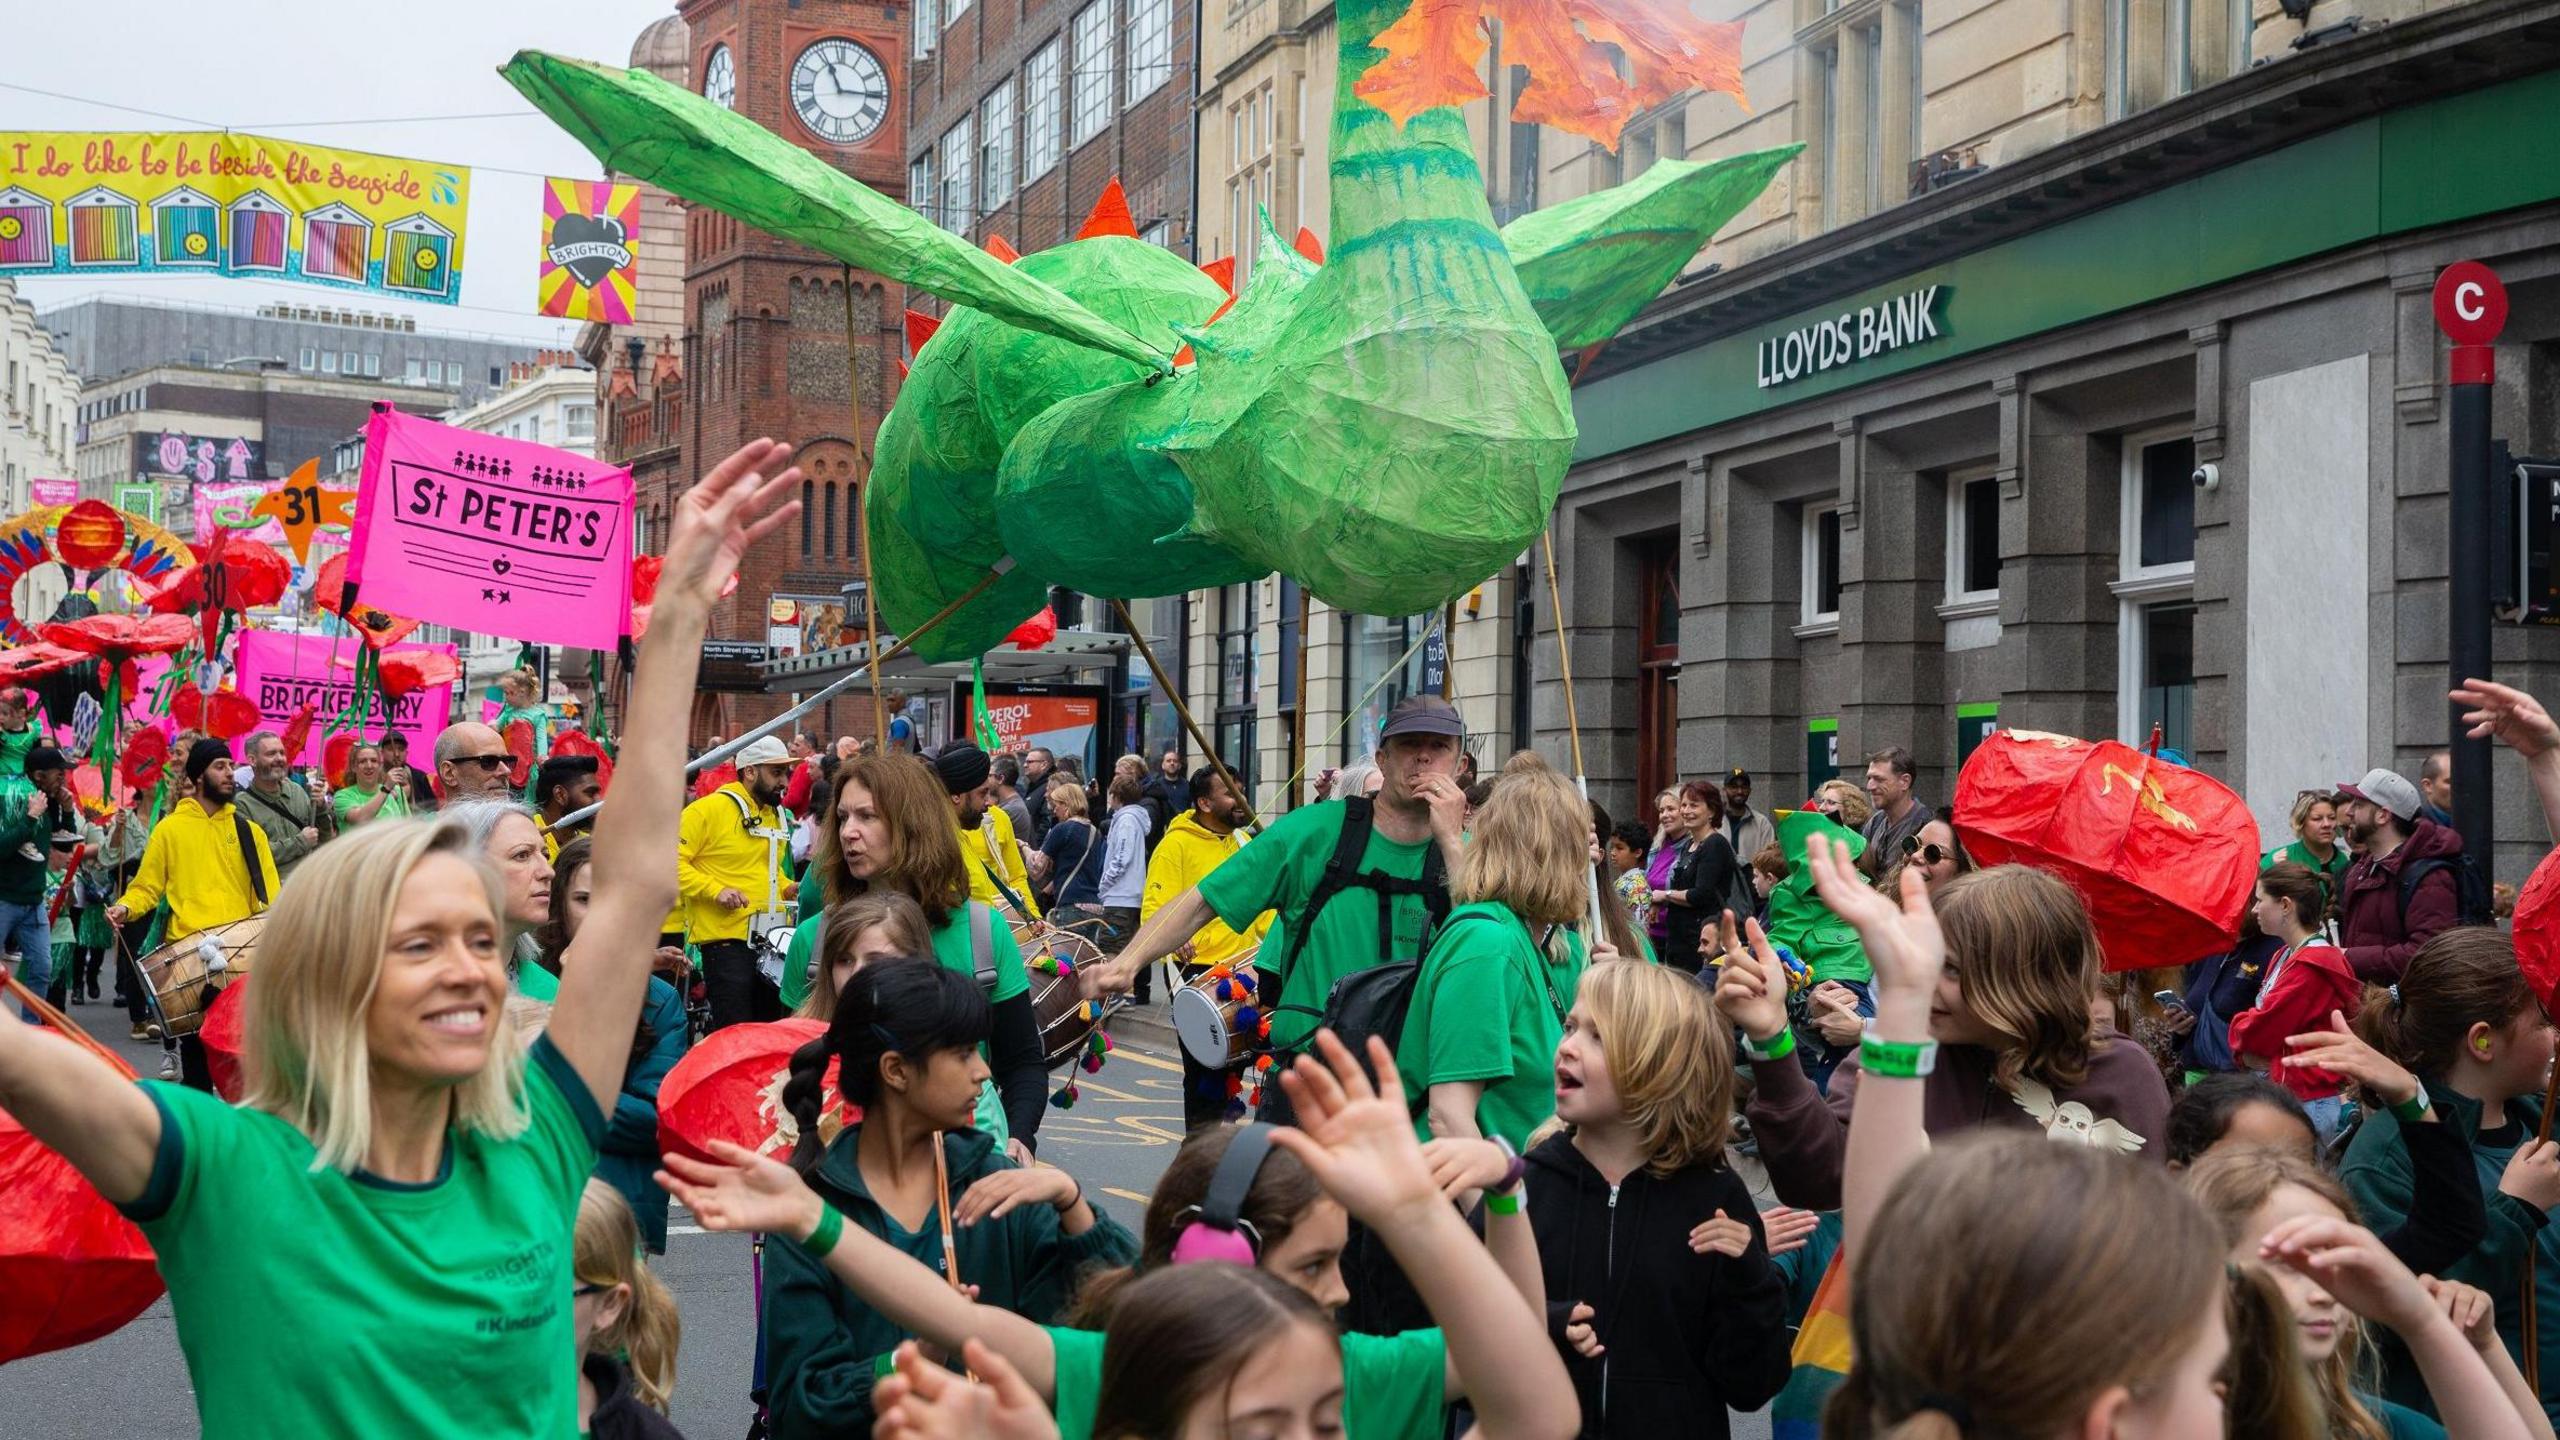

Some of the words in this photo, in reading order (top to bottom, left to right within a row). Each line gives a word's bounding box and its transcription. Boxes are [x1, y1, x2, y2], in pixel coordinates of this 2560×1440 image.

[10, 143, 31, 173] I
[37, 145, 73, 177] do
[83, 138, 133, 174] like
[141, 142, 168, 177] to
[176, 141, 203, 178] be
[209, 142, 277, 180] beside
[283, 151, 322, 185] the
[554, 243, 628, 263] BRIGHTON
[2455, 281, 2485, 321] C
[1758, 313, 1852, 388] LLOYDS
[1859, 285, 1938, 359] BANK
[284, 486, 321, 526] 31
[409, 477, 448, 518] St
[460, 487, 601, 547] PETER'S
[202, 562, 226, 612] 30
[986, 719, 1022, 735] PRITZ
[1000, 734, 1017, 743] OIN
[1010, 742, 1028, 752] JOY
